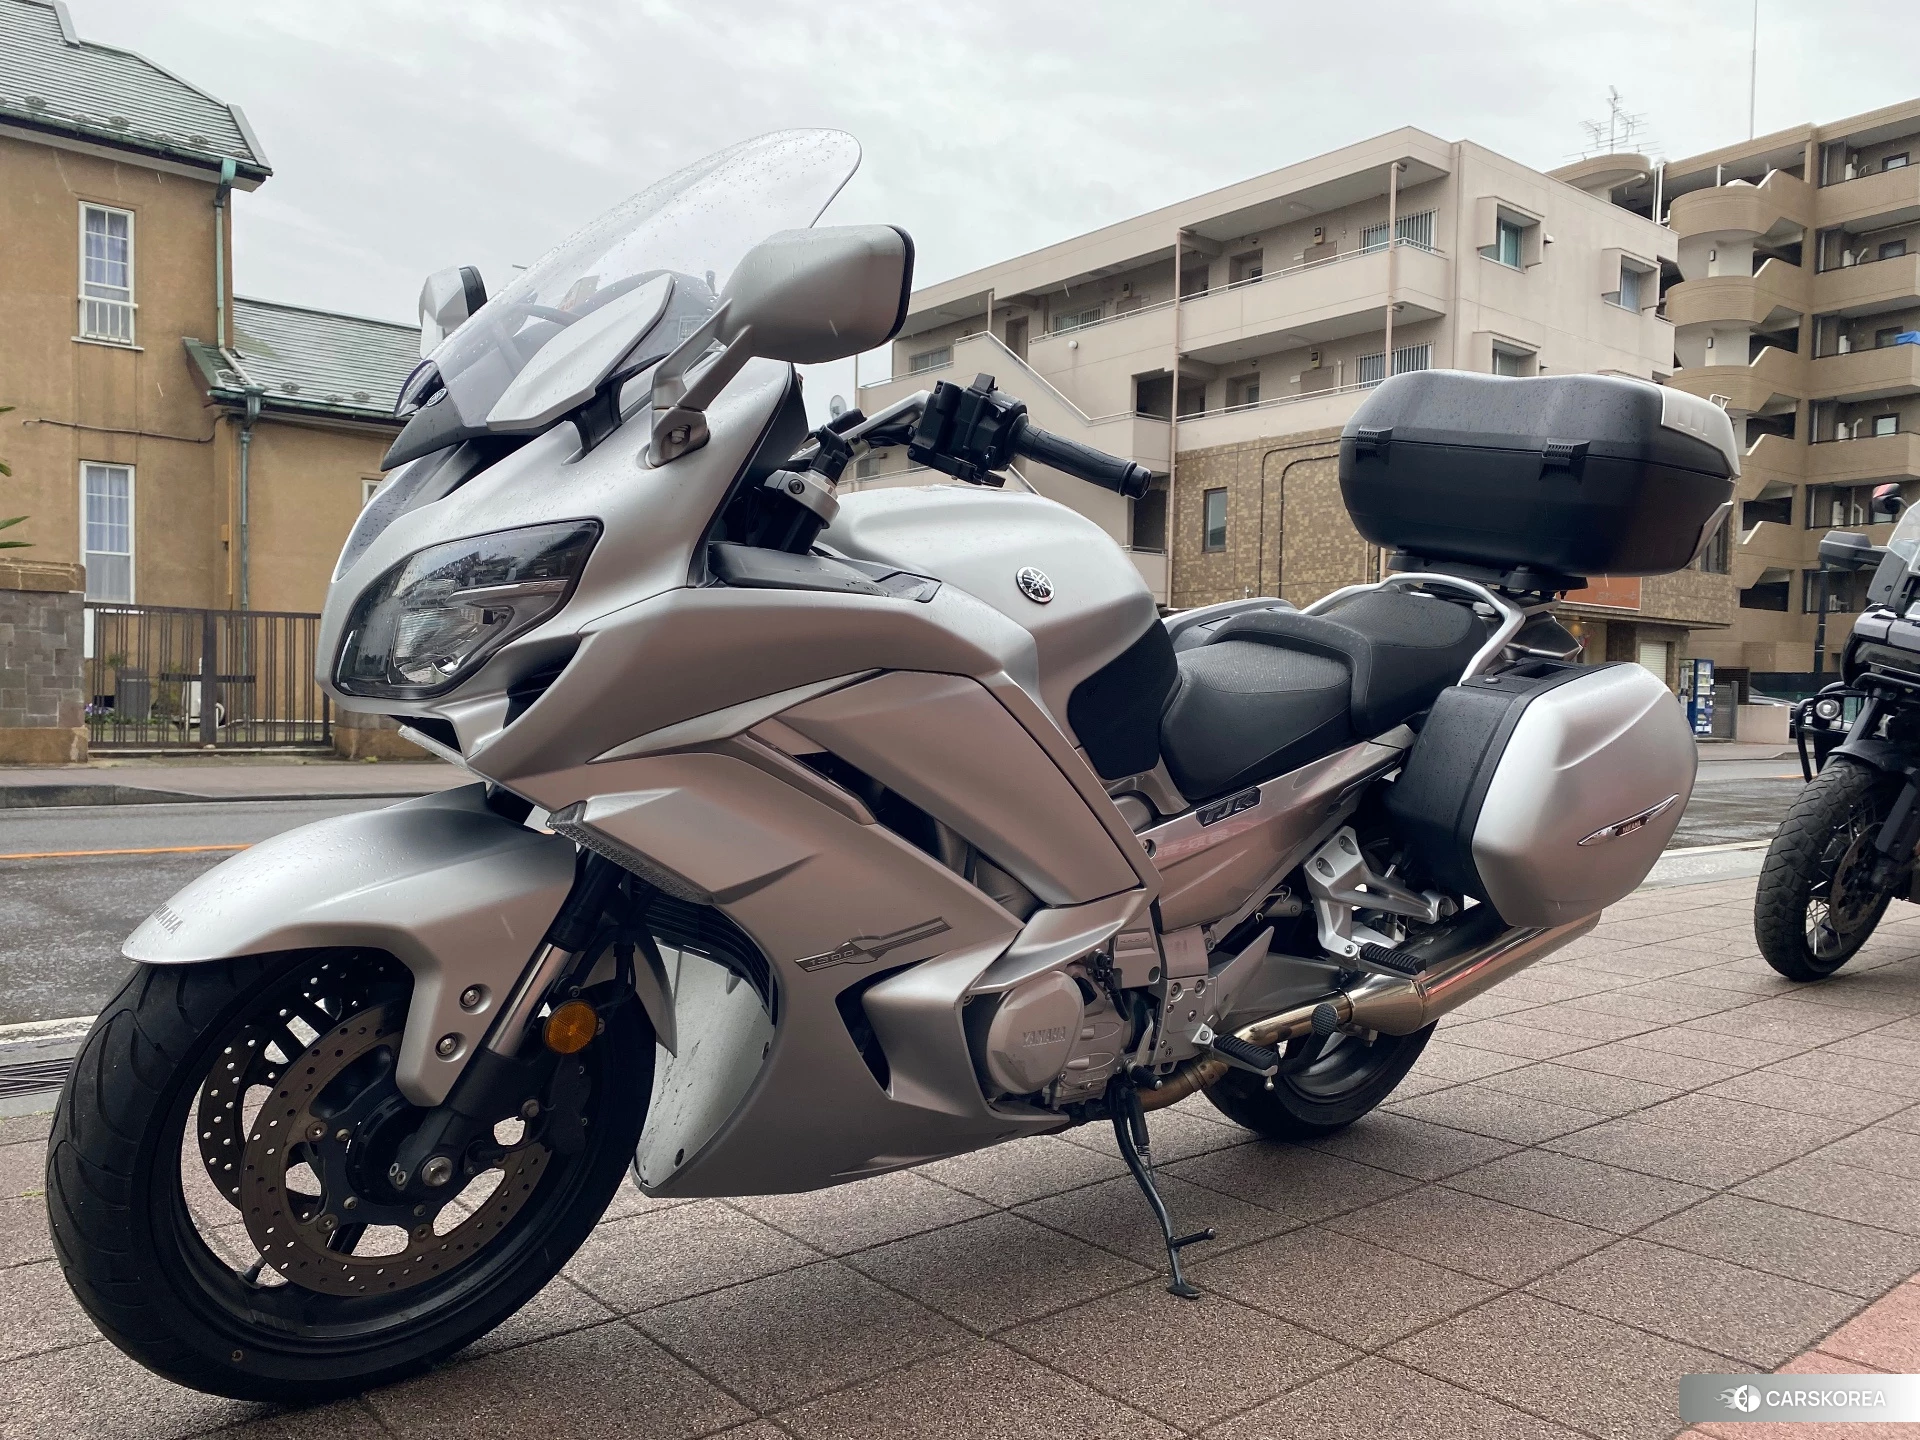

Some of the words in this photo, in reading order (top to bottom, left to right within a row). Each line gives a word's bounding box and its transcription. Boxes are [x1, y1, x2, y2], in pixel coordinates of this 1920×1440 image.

[1203, 787, 1256, 825] FJR
[153, 902, 184, 935] MAHA
[1022, 1026, 1067, 1048] YAMAHA
